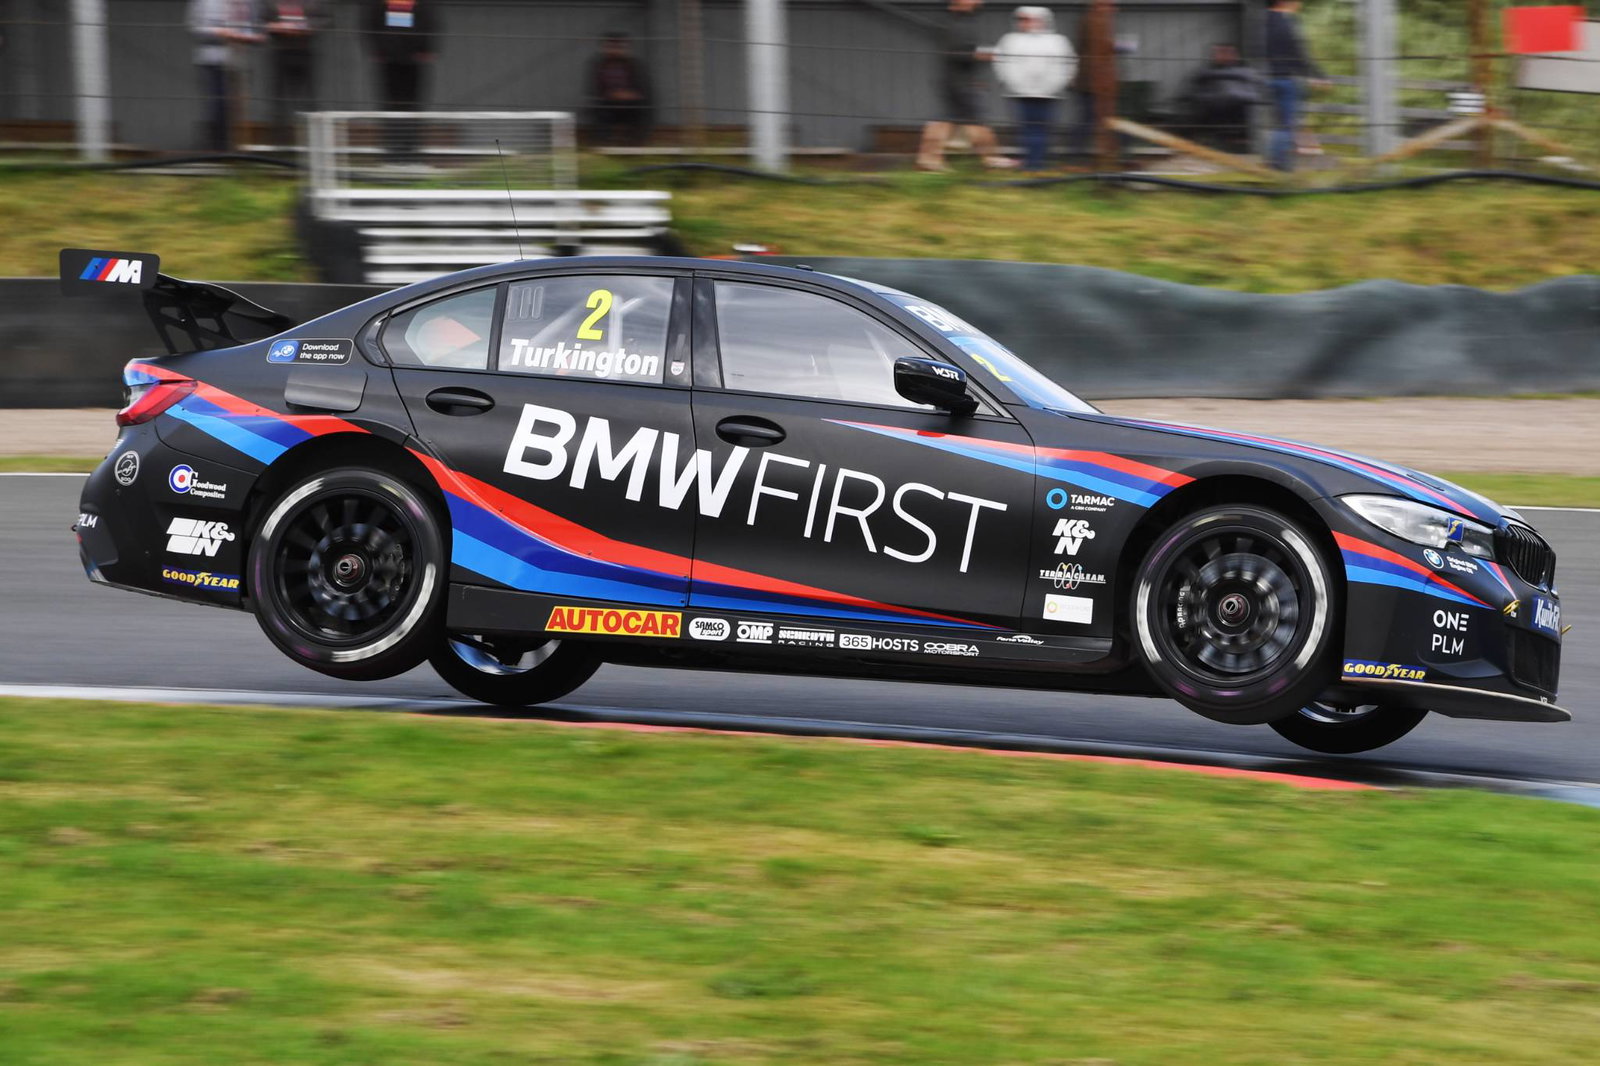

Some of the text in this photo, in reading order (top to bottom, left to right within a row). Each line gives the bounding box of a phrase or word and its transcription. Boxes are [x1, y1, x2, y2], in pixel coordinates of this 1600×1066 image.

[576, 289, 613, 341] 2
[302, 343, 340, 351] Download
[313, 353, 328, 361] app
[510, 338, 659, 377] Turkington
[188, 470, 227, 491] Goodwood
[190, 488, 225, 499] Composites
[1070, 494, 1115, 506] TARMAC
[549, 608, 680, 636] AUTOCAR
[695, 621, 725, 631] SAMCO
[1433, 610, 1470, 631] ONE
[700, 629, 724, 637] sport
[736, 624, 774, 641] OMP
[778, 630, 836, 642] SCHROTH
[777, 640, 834, 648] RACING
[842, 636, 919, 651] 365 HOSTS
[924, 642, 980, 652] COBRA
[1431, 634, 1465, 655] PLM
[924, 648, 979, 657] MOTORSPORT
